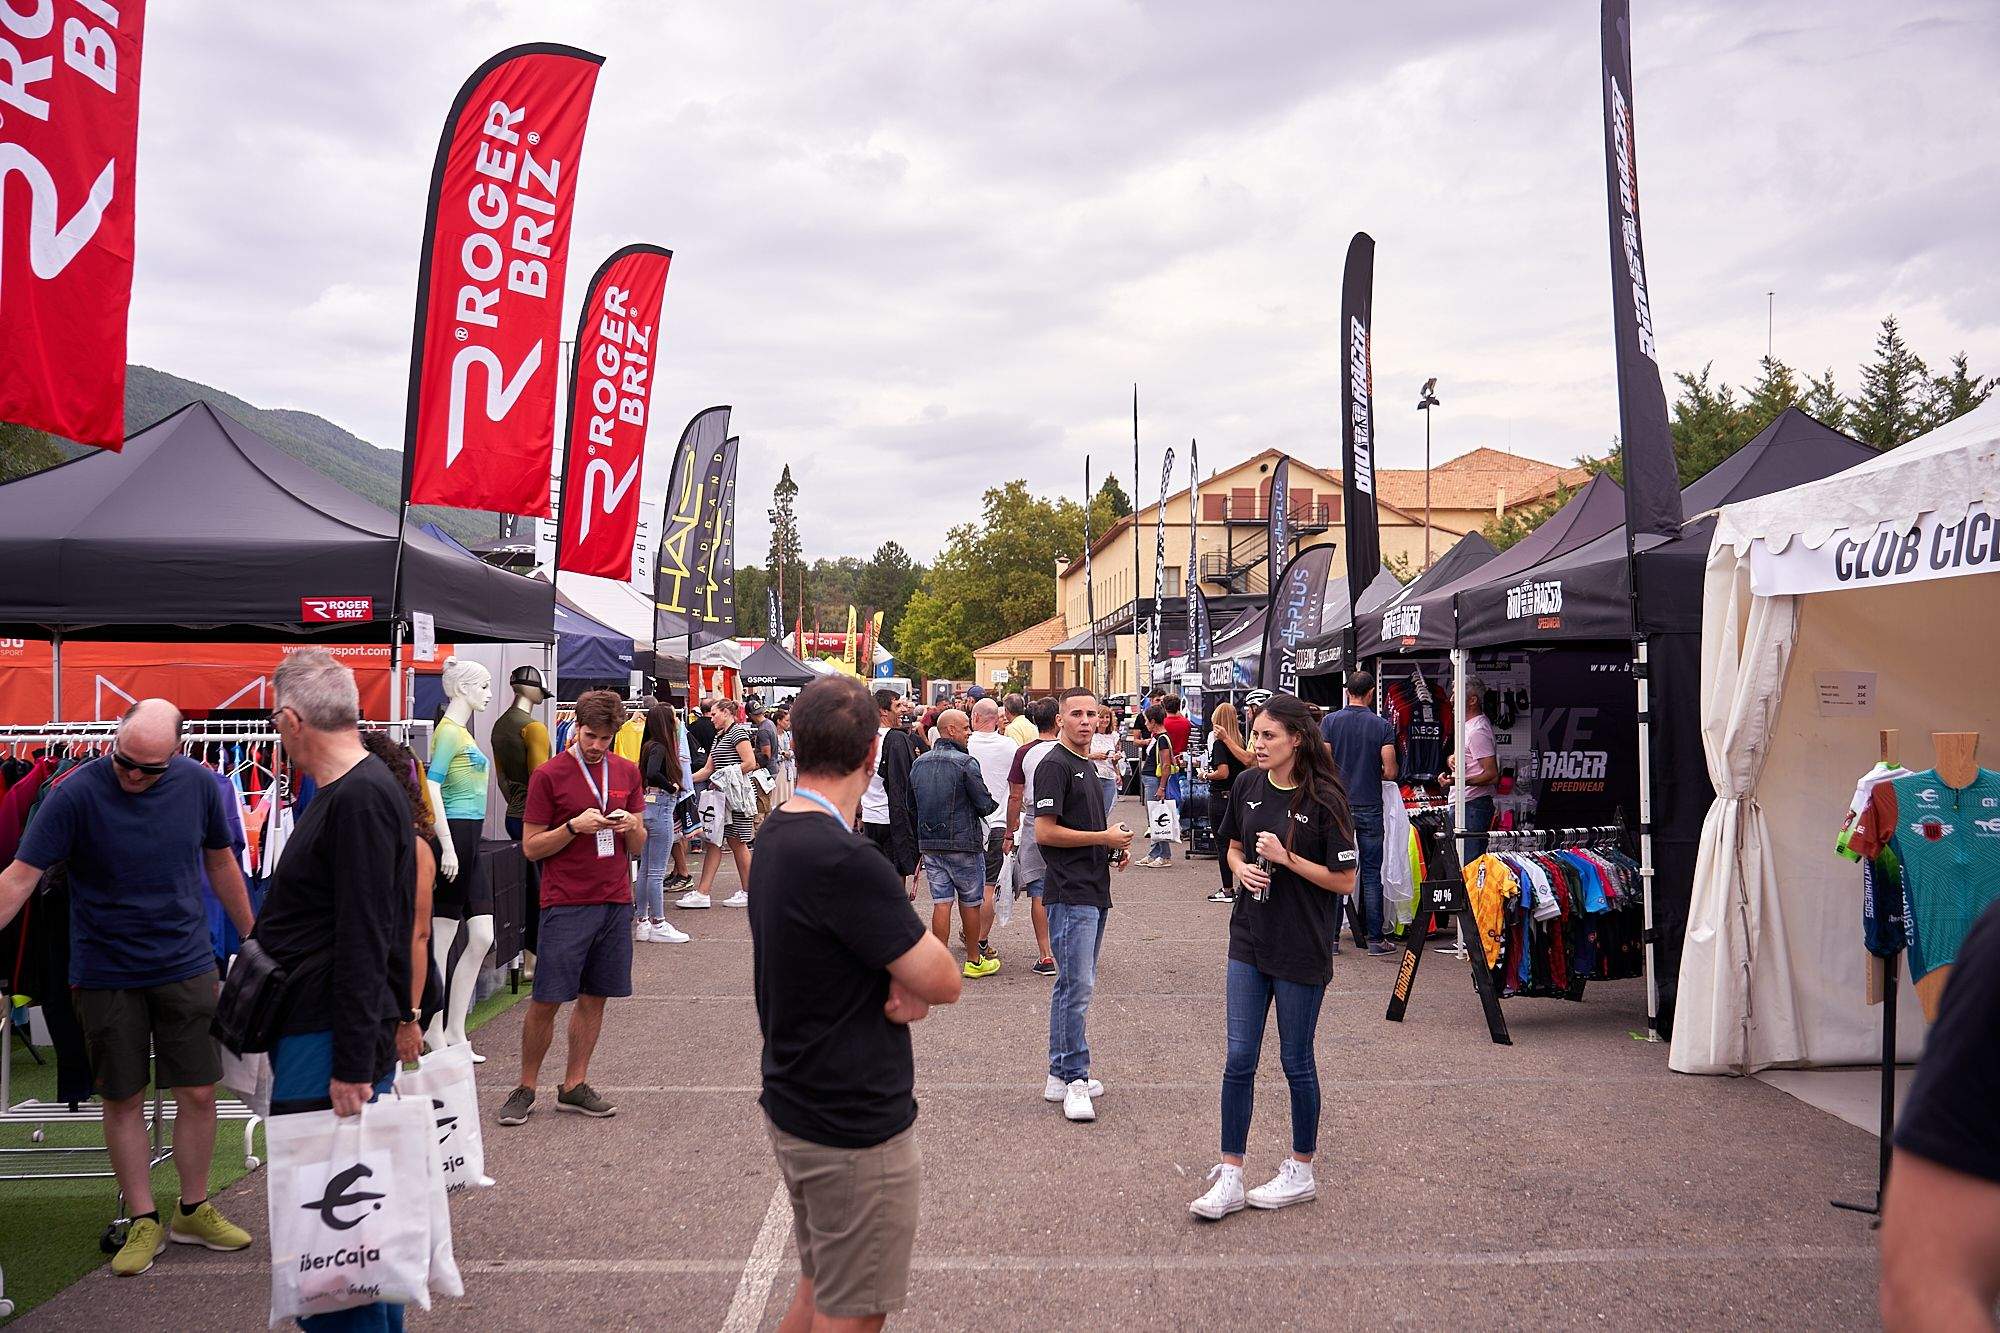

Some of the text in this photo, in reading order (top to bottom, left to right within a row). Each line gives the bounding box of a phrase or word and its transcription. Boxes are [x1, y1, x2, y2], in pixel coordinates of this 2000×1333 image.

[456, 100, 526, 329] ROGER
[508, 148, 561, 299] BRIZ
[588, 285, 630, 447] ROGER
[618, 320, 653, 427] BRIZ
[692, 453, 723, 616] HEADBAND
[1835, 526, 1922, 582] CLUB
[329, 600, 370, 610] ROGER
[1533, 580, 1562, 615] RACER
[336, 610, 364, 619] BRIZ
[747, 676, 778, 684] GSPORT
[1411, 725, 1440, 735] INEOS
[1541, 750, 1608, 779] RACER
[1551, 781, 1605, 792] SPEEDWEAR
[1432, 888, 1452, 903] 50 %
[1394, 949, 1417, 1001] BIORACER
[299, 1245, 380, 1273] iberCaja
